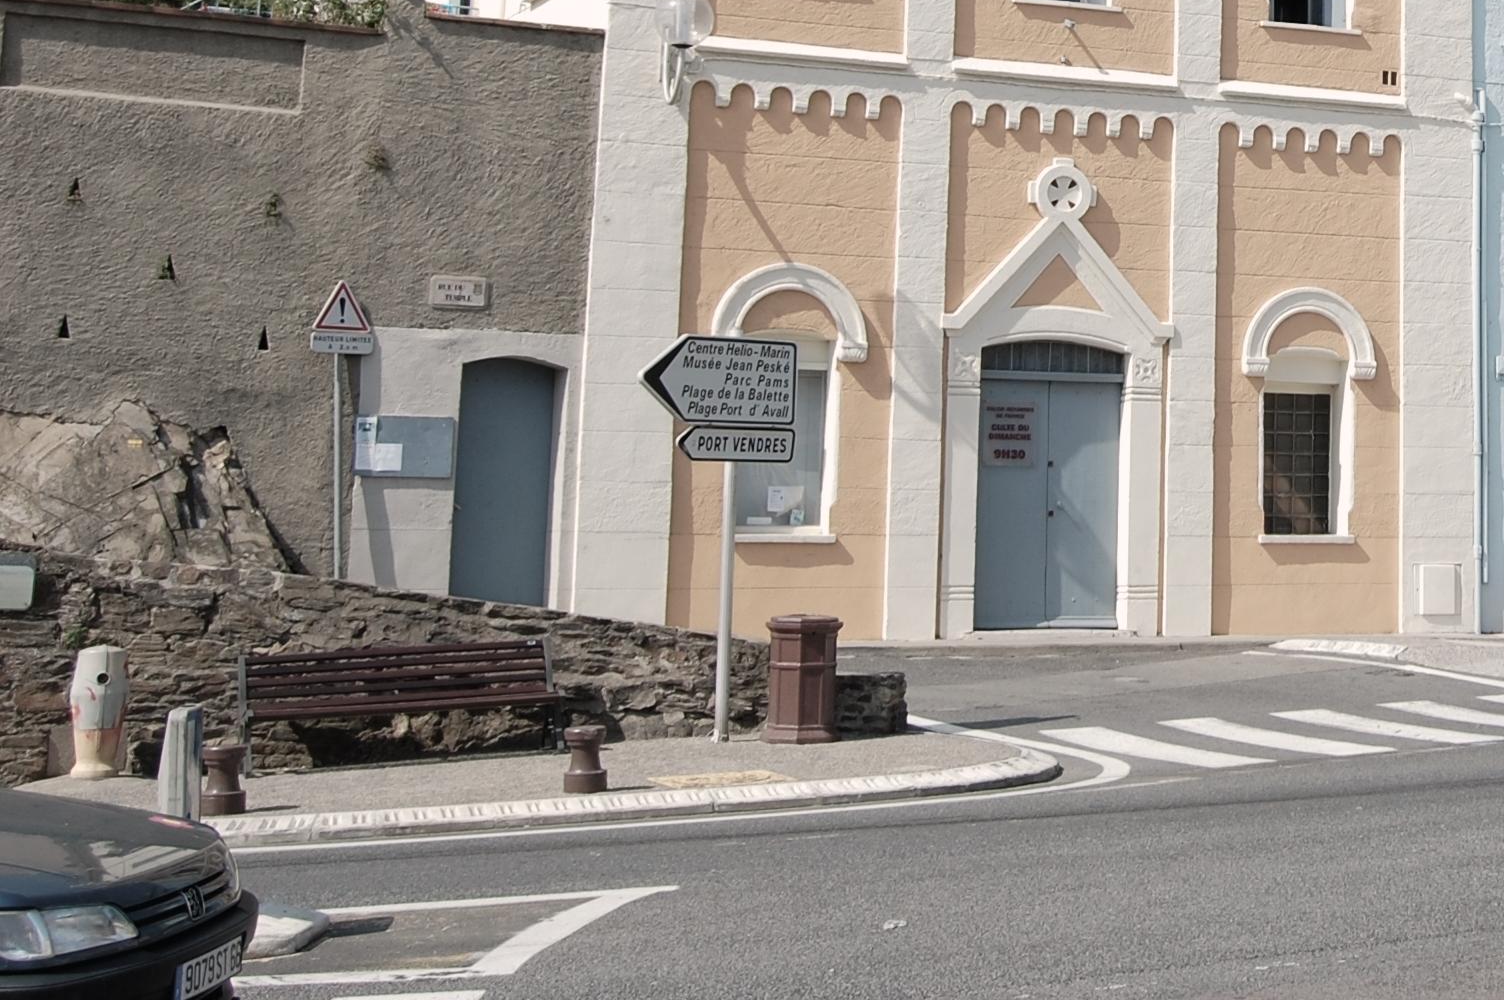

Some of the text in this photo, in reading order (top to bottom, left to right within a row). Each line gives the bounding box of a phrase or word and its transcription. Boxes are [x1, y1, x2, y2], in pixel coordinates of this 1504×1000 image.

[687, 341, 725, 356] Centre
[682, 356, 790, 374] Musée Jean Peské
[724, 373, 789, 388] Parc Pams
[681, 385, 789, 402] Plage de la Balette
[687, 401, 718, 417] Plage
[720, 403, 742, 416] Port
[762, 405, 789, 418] Avall
[1018, 424, 1030, 432] DU
[698, 436, 787, 453] PORT VENDRES
[185, 955, 215, 994] 9079
[216, 946, 229, 979] ST
